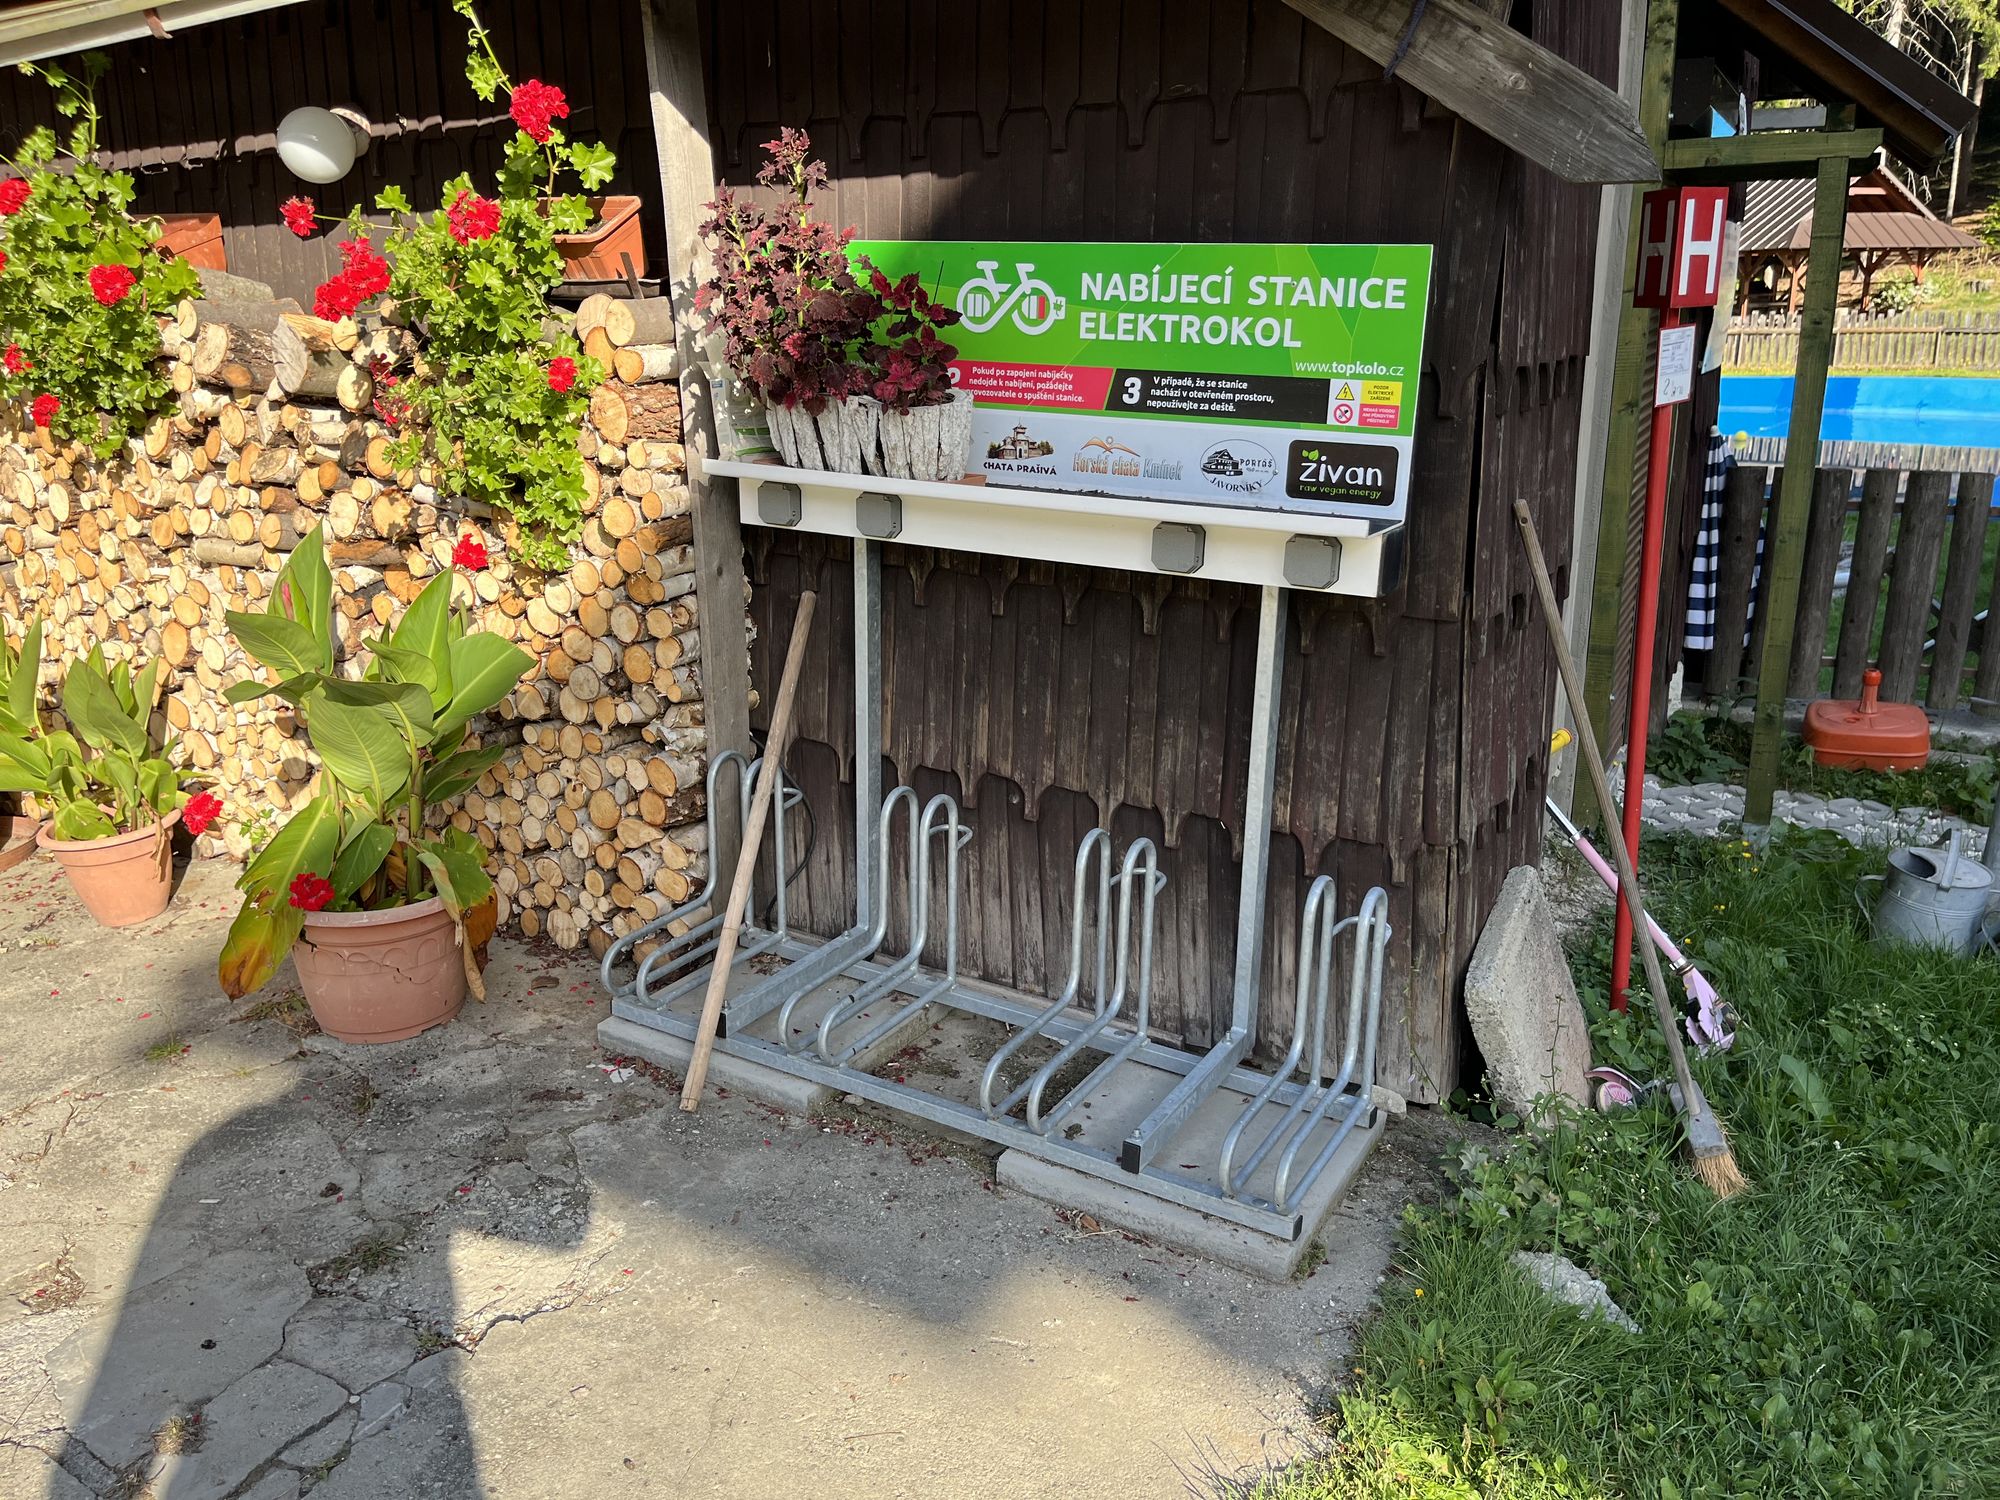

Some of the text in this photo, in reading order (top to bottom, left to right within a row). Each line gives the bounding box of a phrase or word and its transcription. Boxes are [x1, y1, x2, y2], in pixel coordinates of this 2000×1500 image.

[1637, 200, 1676, 296] H
[1678, 198, 1724, 296] H
[1080, 263, 1407, 310] NABÍJECÍ STANICE
[1079, 311, 1302, 348] ELEKTROKOL
[972, 366, 1073, 381] Pokud po zapojení nabíječky
[1295, 361, 1405, 377] www.topkolo.cz
[969, 377, 1073, 392] nedojde k nabíjení, požádejte
[1122, 376, 1142, 405] 3
[1153, 376, 1248, 389] V případě, že se stanice
[1023, 391, 1055, 401] spuštění
[1055, 393, 1085, 403] stanice.
[1150, 387, 1181, 397] nachází
[1188, 389, 1234, 400] otevřeném
[1234, 393, 1275, 404] prostoru,
[1146, 399, 1236, 412] nepoužívejte za deště.
[983, 461, 1057, 476] CHATA PRAŠIVÁ
[1072, 452, 1109, 473] Horská
[1299, 484, 1382, 500] raw vegan energy
